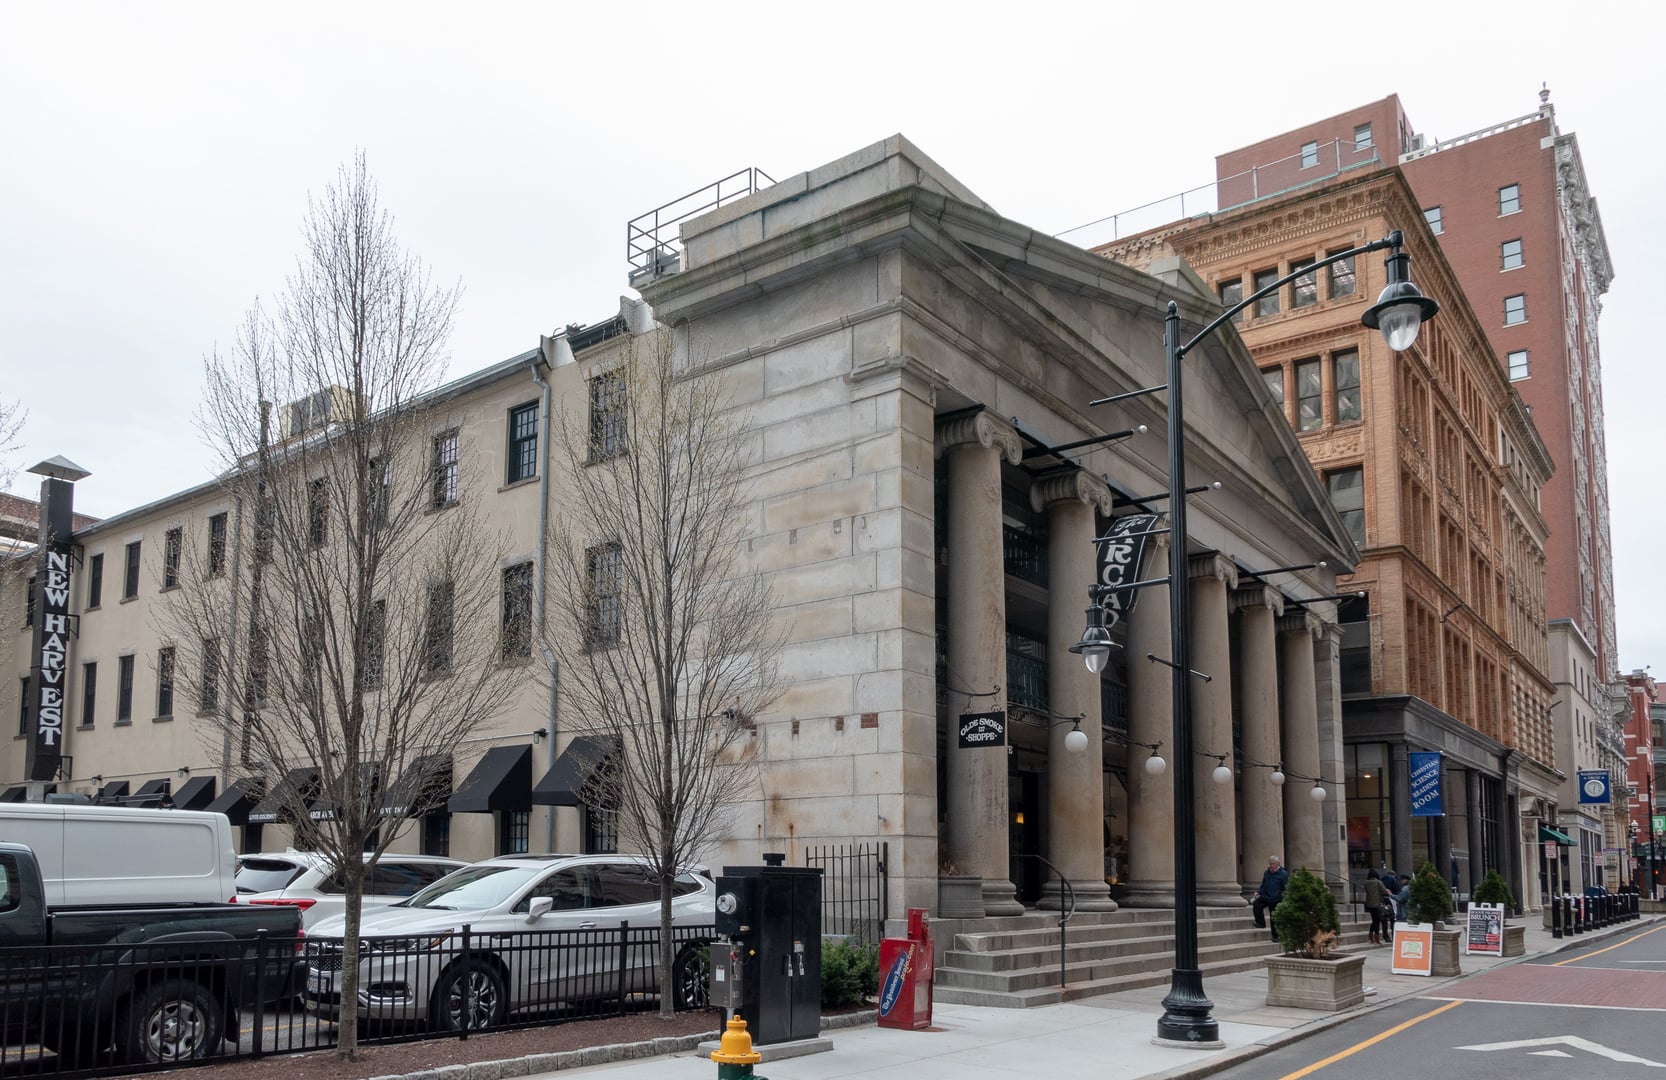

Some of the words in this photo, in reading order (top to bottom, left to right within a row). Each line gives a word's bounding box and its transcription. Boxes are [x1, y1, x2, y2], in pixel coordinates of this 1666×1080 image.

[1114, 518, 1147, 532] The
[44, 551, 69, 608] NEW
[38, 612, 67, 746] HARVEST
[960, 719, 979, 736] OLDE
[979, 717, 1004, 733] SMOKE
[1411, 760, 1439, 778] CHRISTIAN
[1411, 769, 1439, 788] SCIENCE
[1412, 779, 1439, 798] READING
[1412, 790, 1439, 809] ROOM
[900, 943, 915, 981] projo.com
